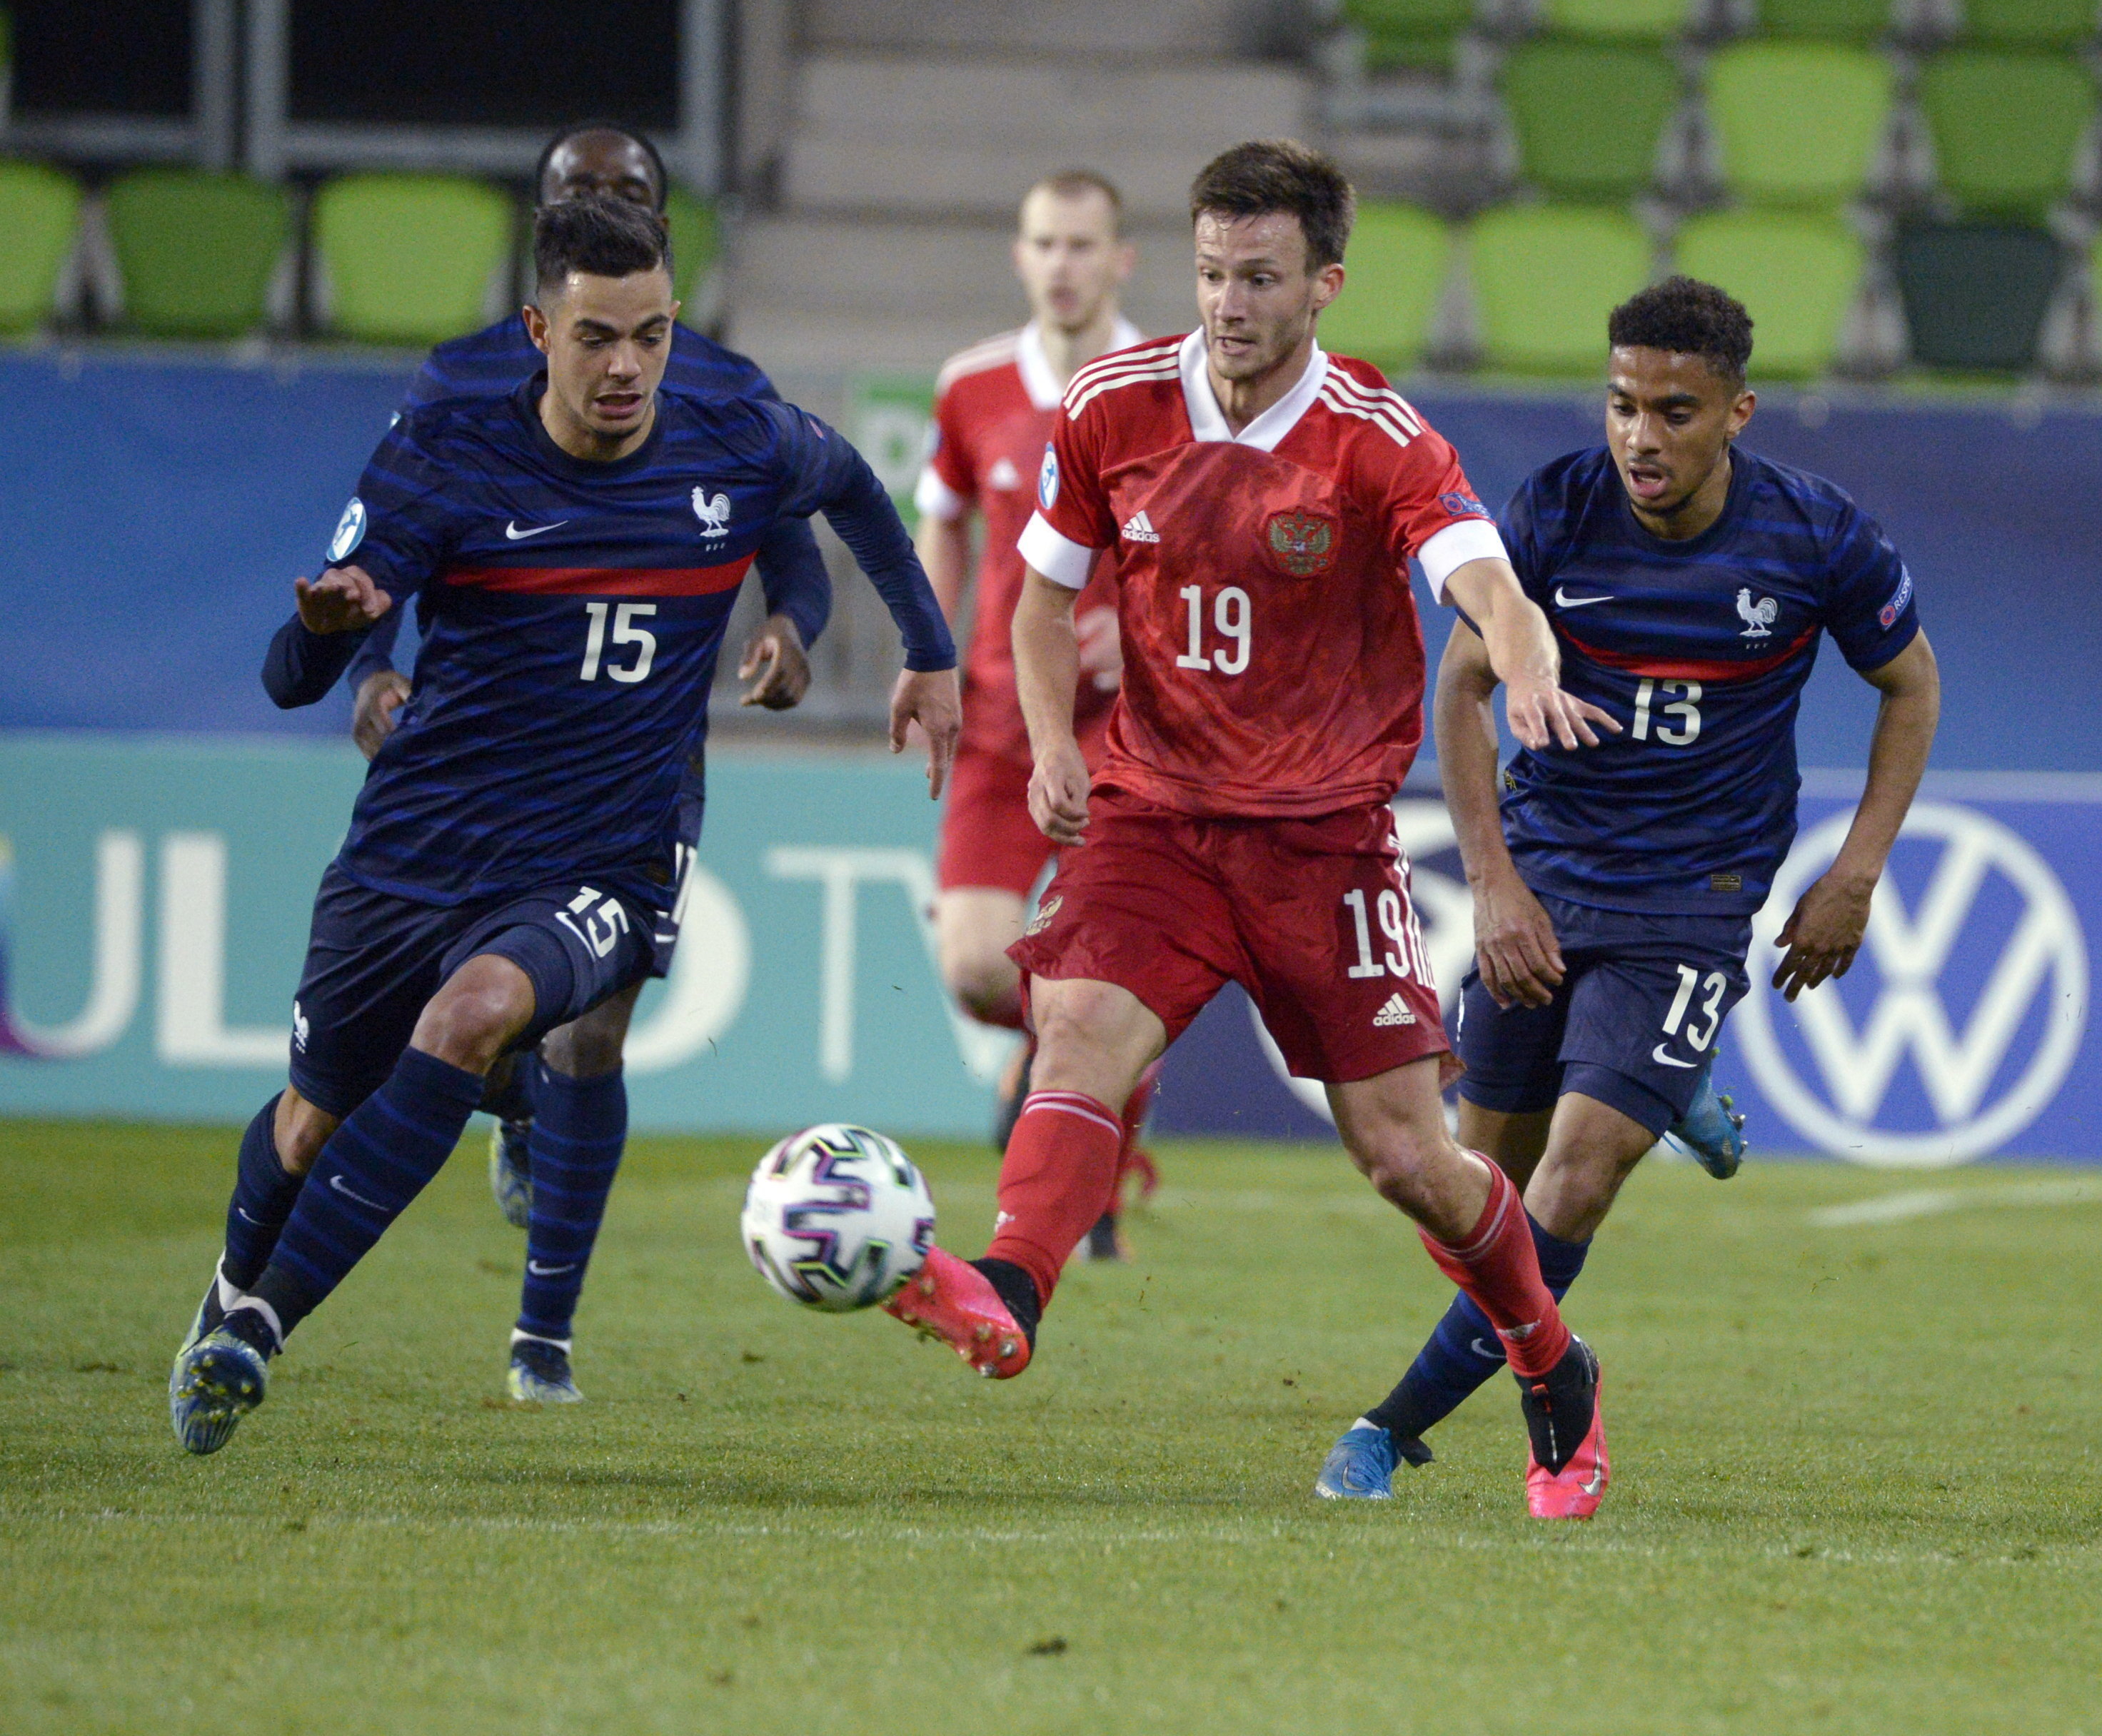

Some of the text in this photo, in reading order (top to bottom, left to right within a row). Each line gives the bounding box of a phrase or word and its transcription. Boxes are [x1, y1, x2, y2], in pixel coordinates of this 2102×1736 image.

[1121, 528, 1160, 543] adidas
[580, 602, 658, 683] 15
[1176, 584, 1252, 675] 19
[1631, 677, 1703, 746] 13
[567, 886, 630, 957] 15
[1343, 888, 1410, 979] 19
[1372, 1013, 1417, 1026] adidas
[1664, 964, 1726, 1052] 13
